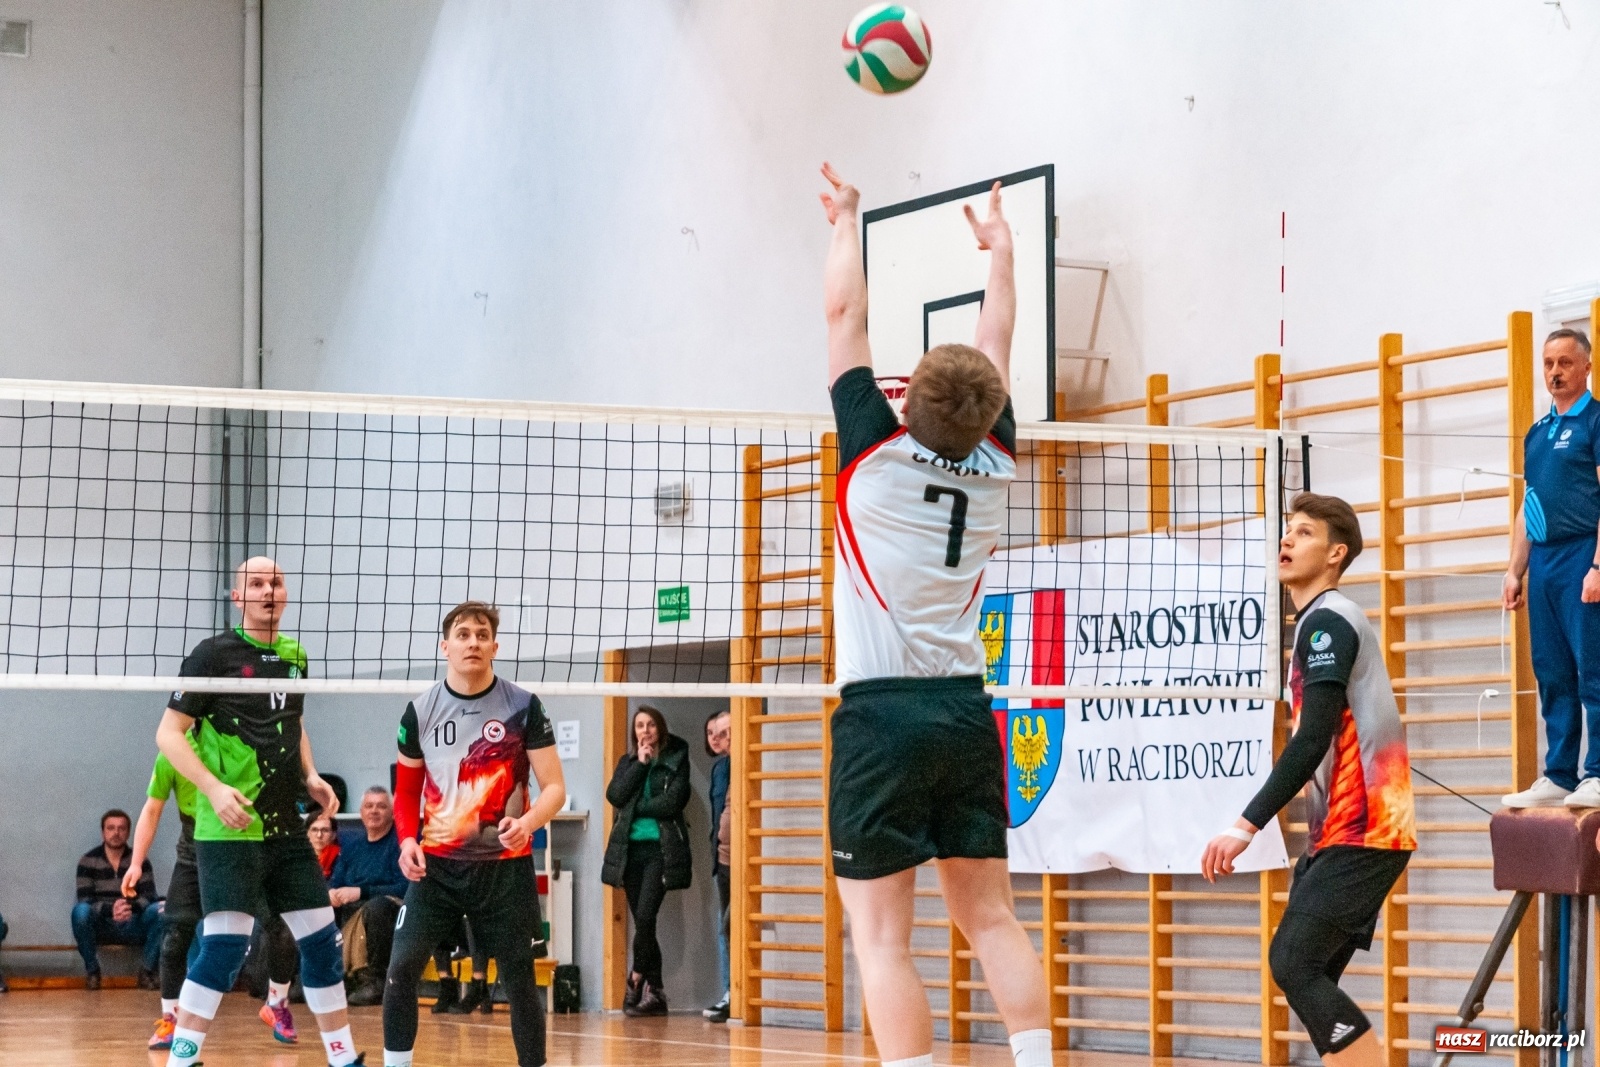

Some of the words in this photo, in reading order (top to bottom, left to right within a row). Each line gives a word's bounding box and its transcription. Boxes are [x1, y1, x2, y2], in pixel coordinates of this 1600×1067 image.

[923, 483, 969, 568] 7
[1078, 597, 1263, 655] STAROSTWO
[1080, 670, 1265, 722] POWIATOWE
[433, 719, 457, 748] 10
[1078, 748, 1102, 783] W
[1108, 739, 1263, 782] RACIBORZU
